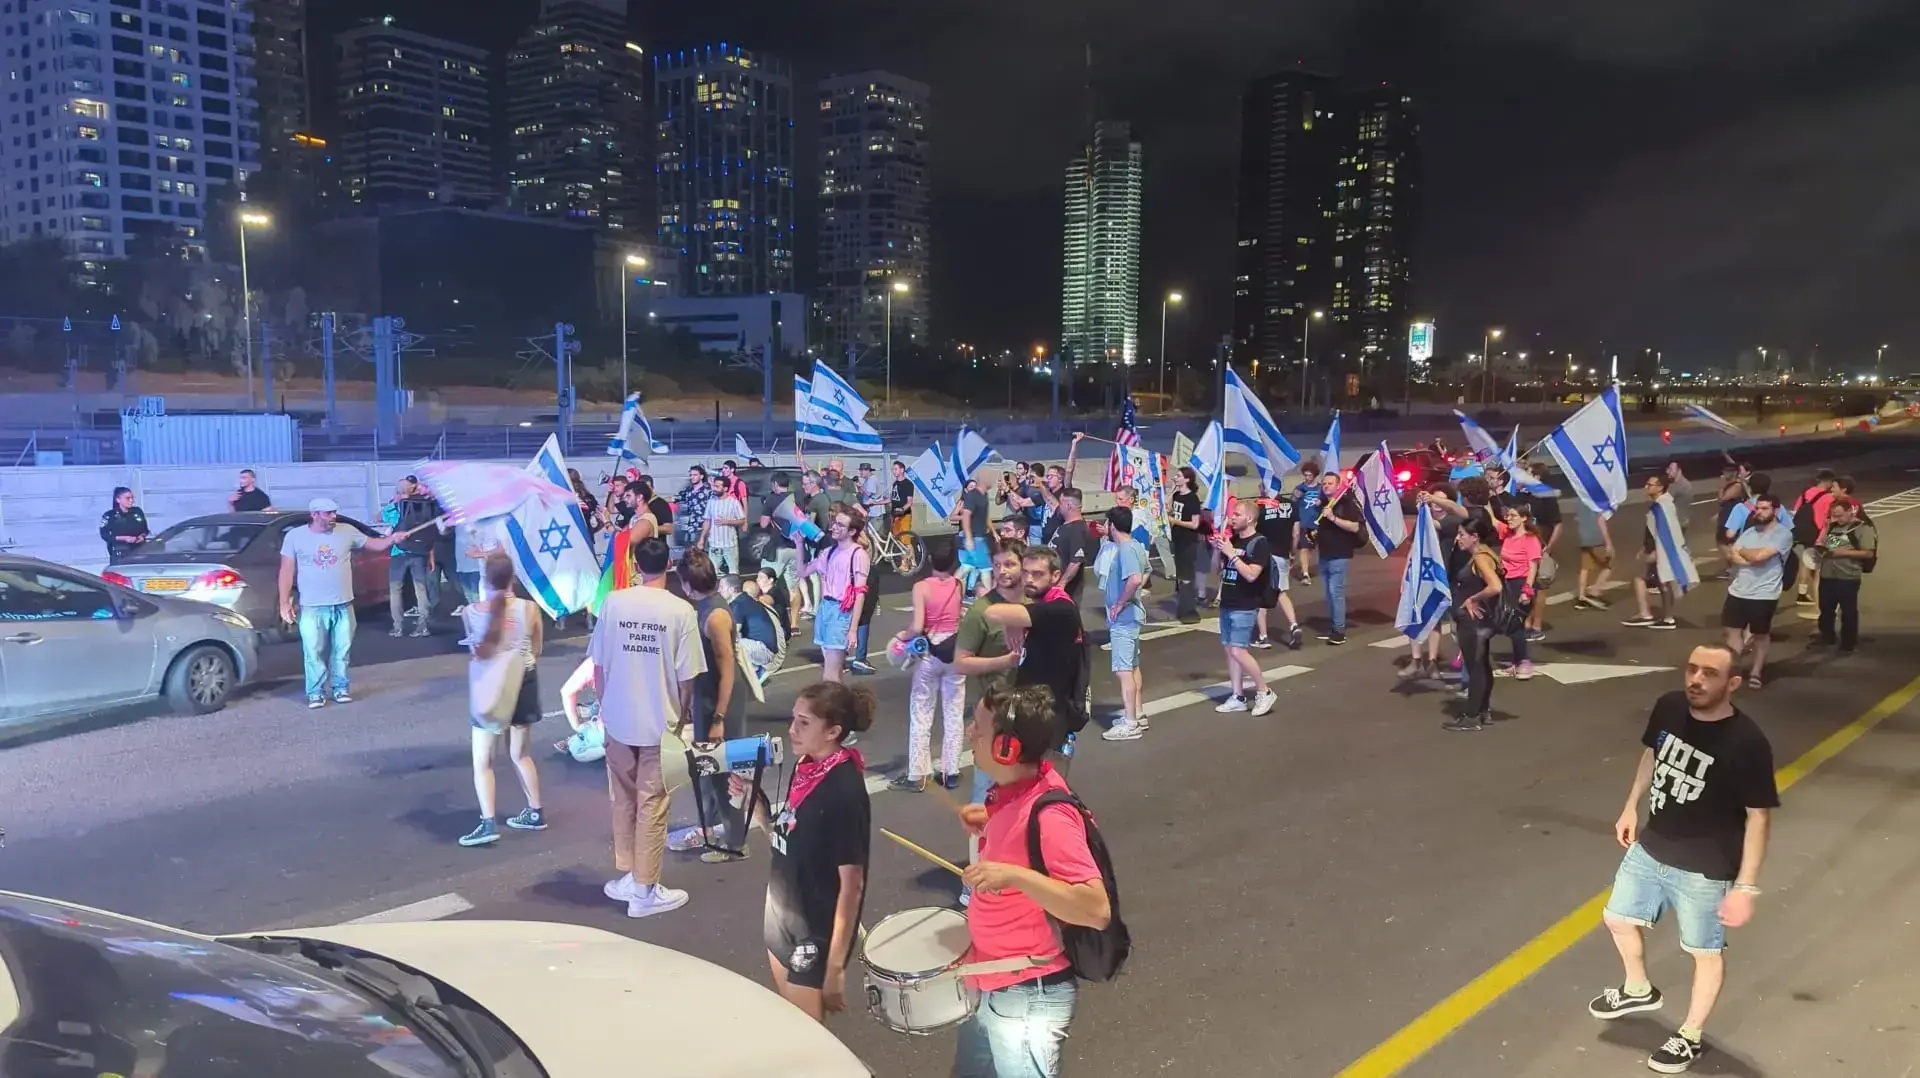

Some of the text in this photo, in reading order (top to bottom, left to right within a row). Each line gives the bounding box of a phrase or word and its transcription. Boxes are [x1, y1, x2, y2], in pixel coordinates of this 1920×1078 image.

[619, 621, 667, 632] NOT FROM
[629, 633, 656, 642] PARIS
[622, 644, 661, 655] MADAME
